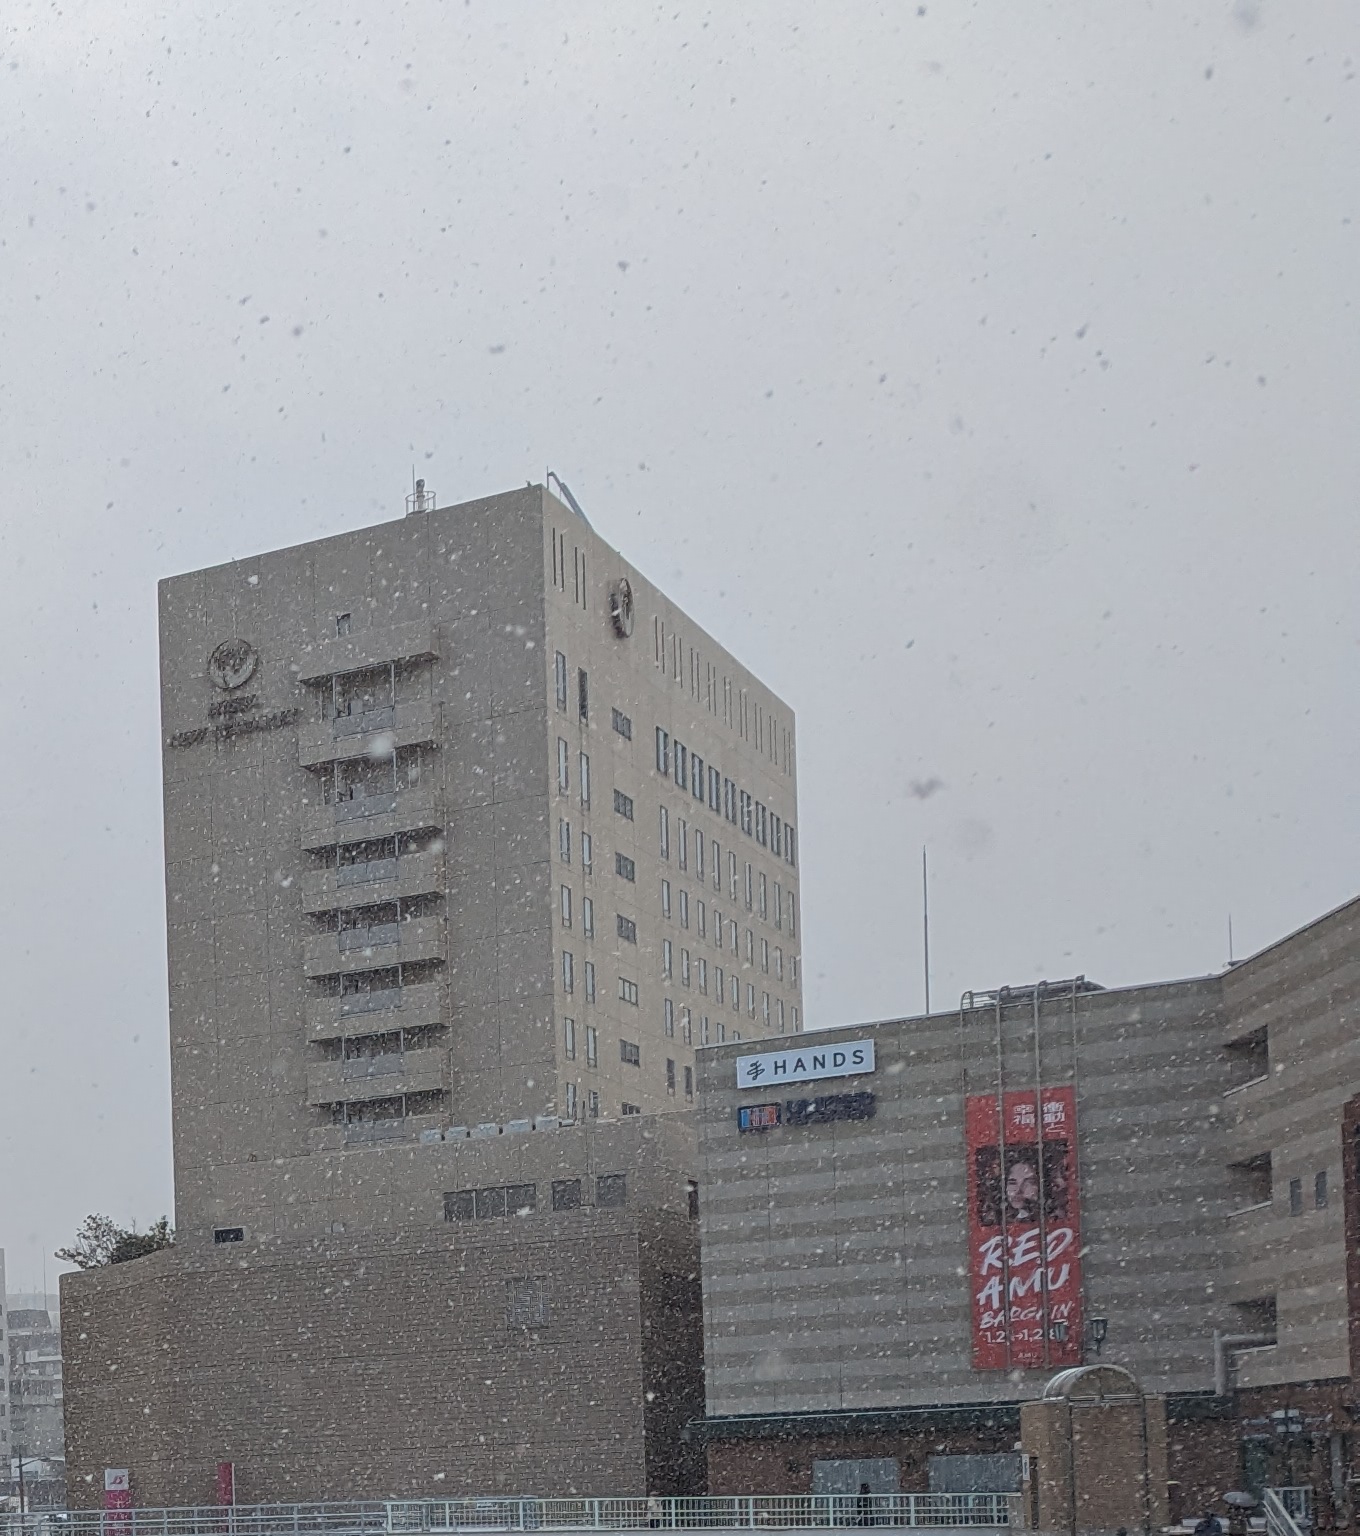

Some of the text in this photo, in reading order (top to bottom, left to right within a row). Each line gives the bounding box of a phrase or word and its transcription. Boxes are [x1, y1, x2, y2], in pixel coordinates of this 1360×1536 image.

[774, 1050, 864, 1076] HANDS
[978, 1227, 1074, 1276] RED
[976, 1263, 1071, 1310] AMU
